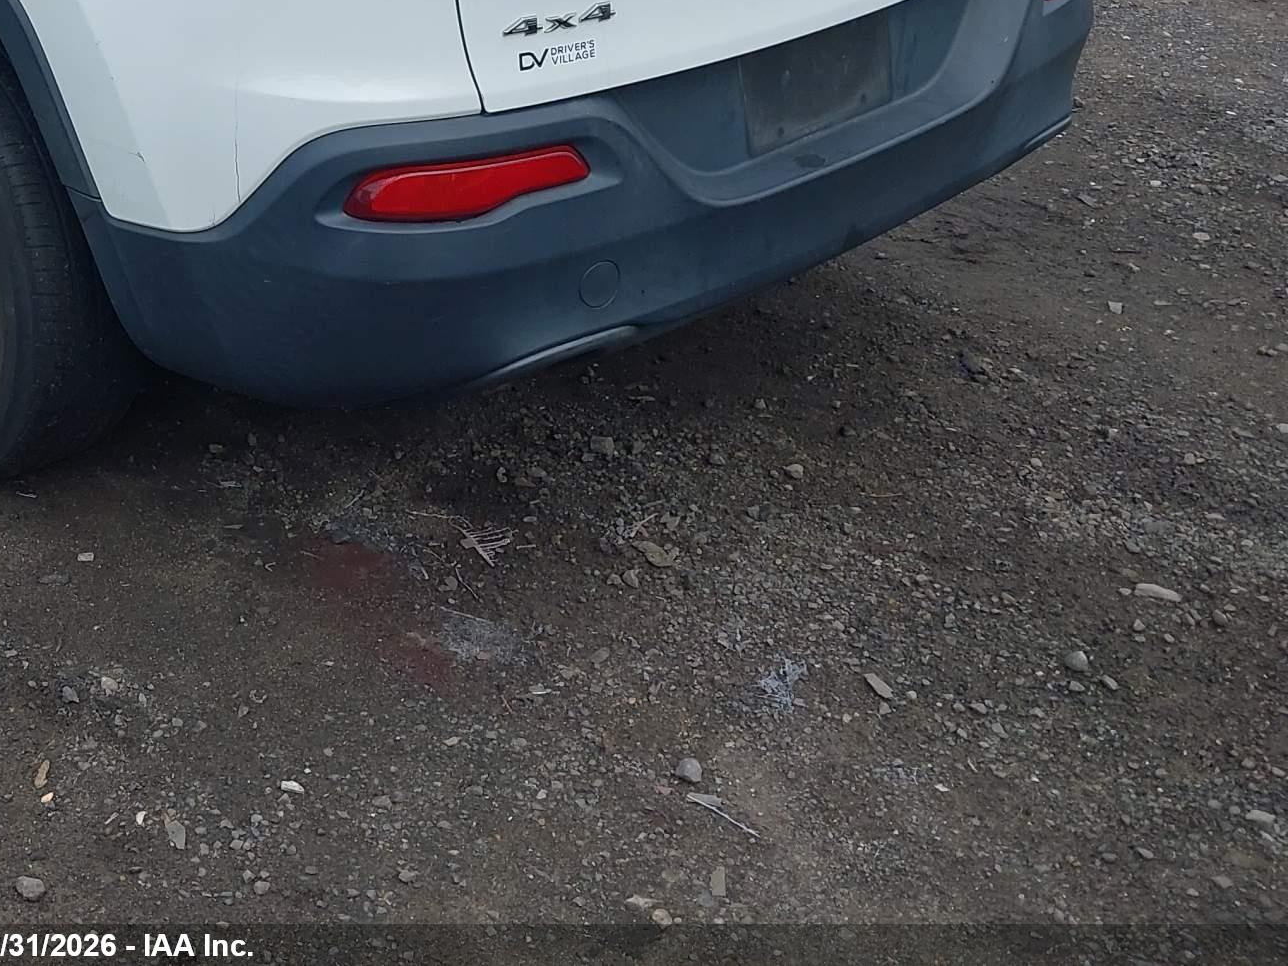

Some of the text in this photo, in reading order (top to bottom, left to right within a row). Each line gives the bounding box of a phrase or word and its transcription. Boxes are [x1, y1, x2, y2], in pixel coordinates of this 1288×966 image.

[550, 39, 595, 56] DRIVER'S
[518, 48, 549, 71] DV
[551, 48, 596, 65] VILLAGE
